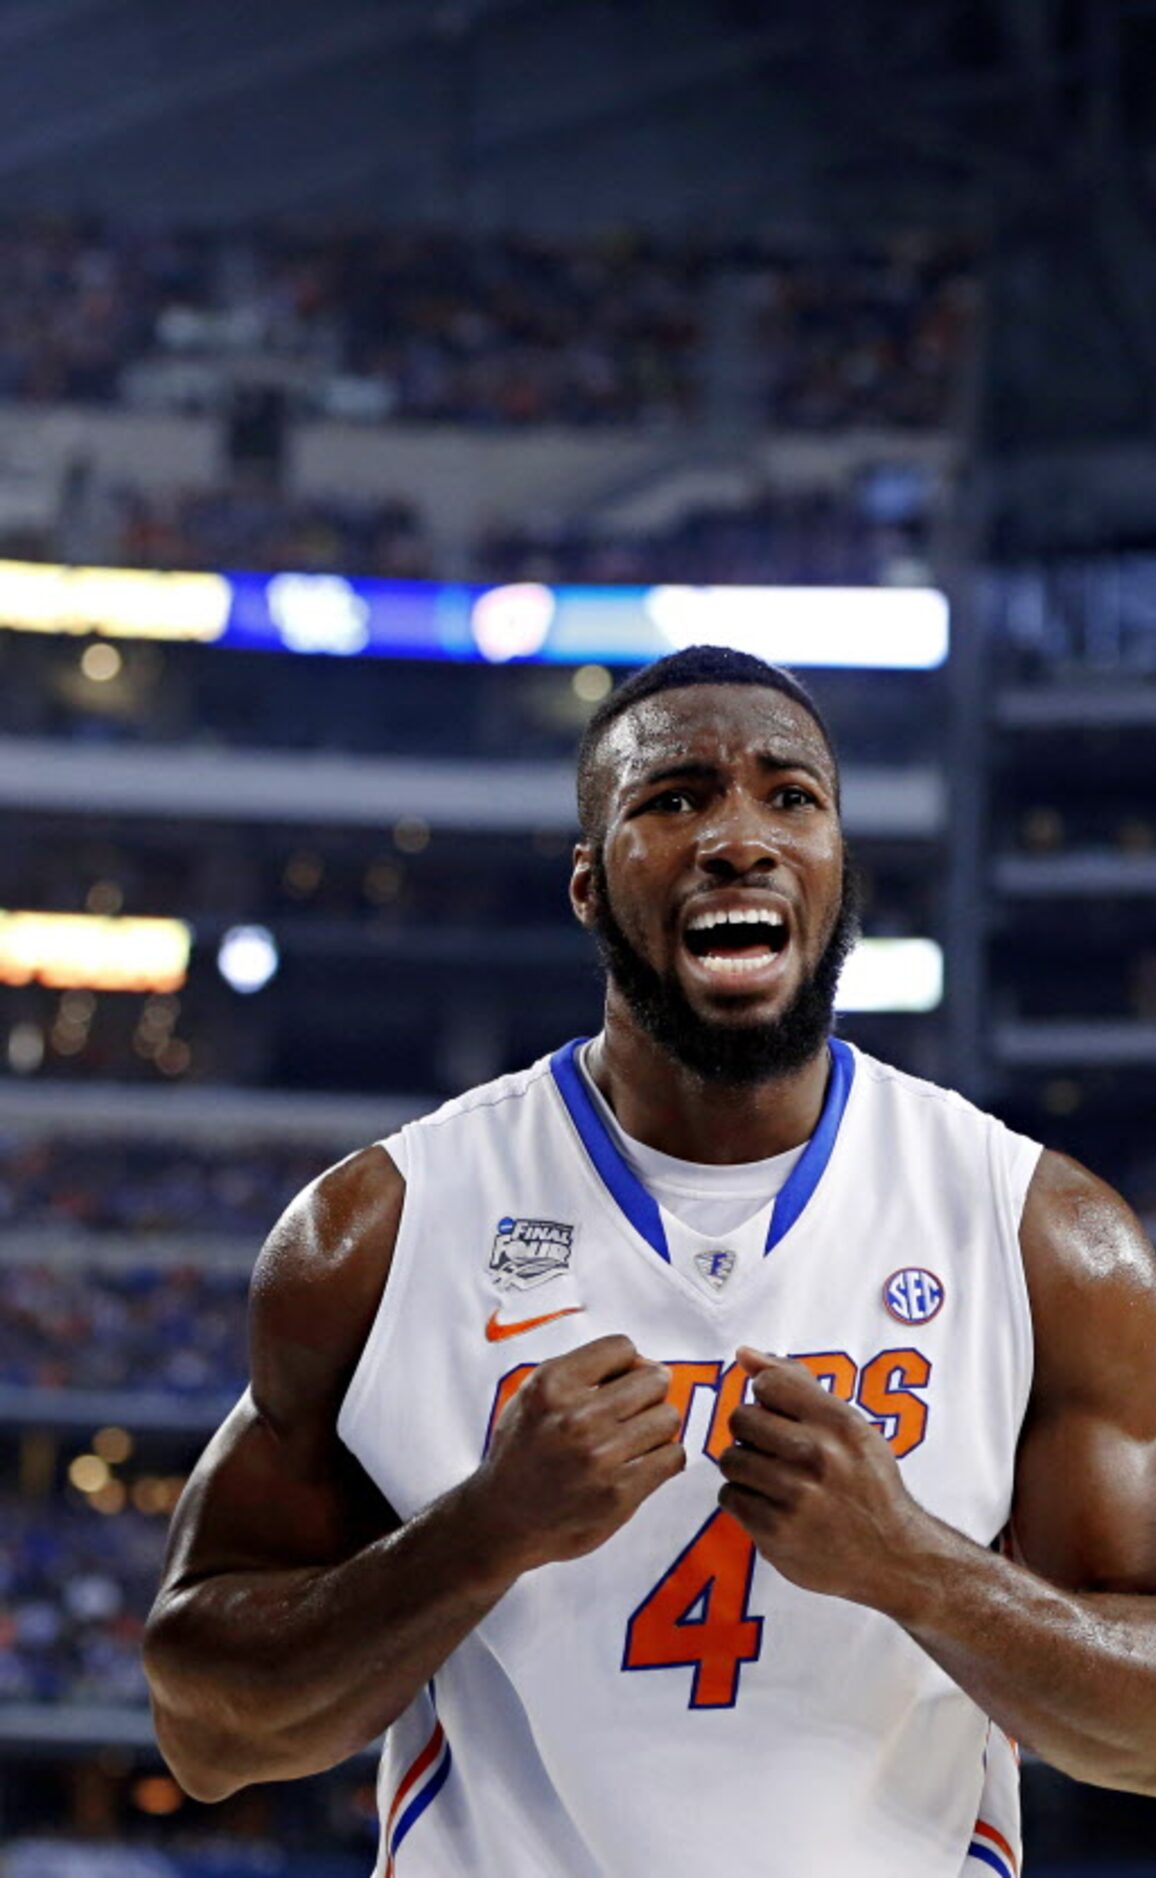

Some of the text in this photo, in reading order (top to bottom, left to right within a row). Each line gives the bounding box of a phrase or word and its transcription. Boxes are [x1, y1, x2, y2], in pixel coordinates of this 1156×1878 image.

[491, 1235, 571, 1268] FOUR
[511, 1220, 571, 1247] FINAL
[887, 1270, 941, 1319] SEC
[483, 1347, 932, 1466] TORS
[620, 1505, 765, 1710] 4
